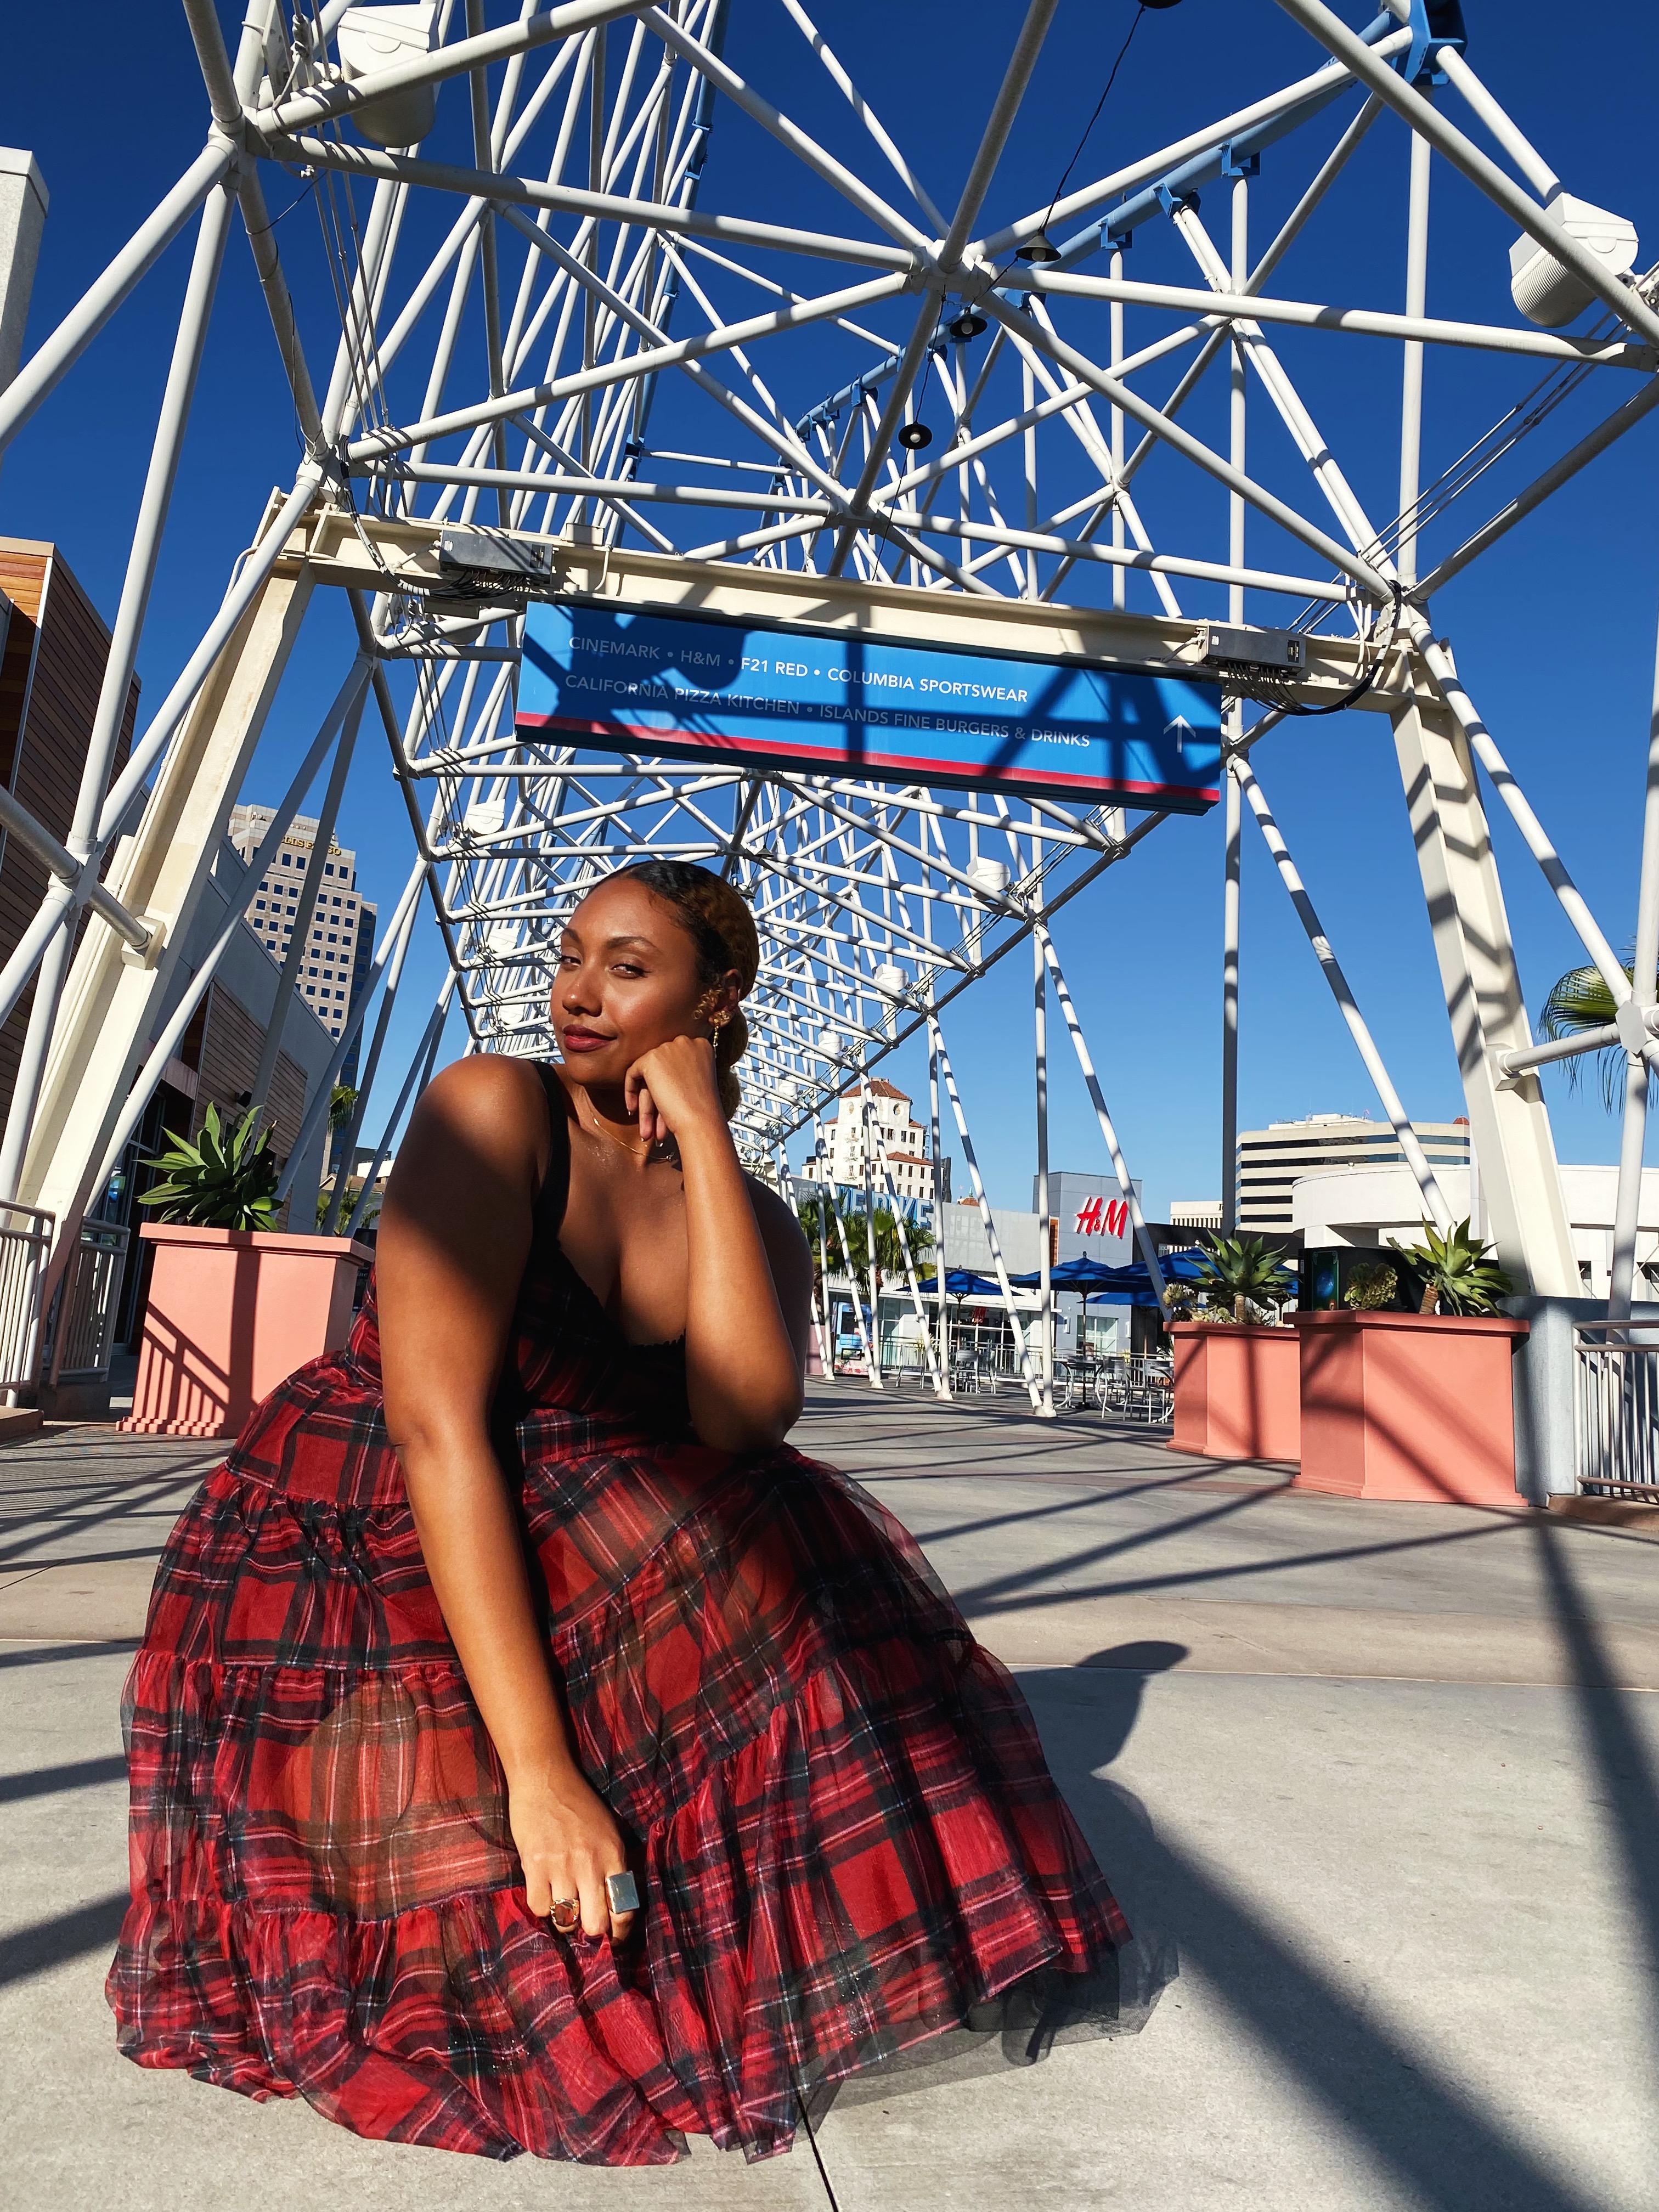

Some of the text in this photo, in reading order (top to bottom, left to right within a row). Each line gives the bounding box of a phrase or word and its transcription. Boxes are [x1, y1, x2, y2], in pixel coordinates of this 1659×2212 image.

[569, 637, 1028, 703] CINEMARK H&M F21 RED COLUMBIA SPORTSWEAR
[565, 675, 1091, 748] CALIFORNIA PIZZA KITCHEN ISLANDS FINE BURGERS & DRINKS
[1075, 1196, 1129, 1240] H&M
